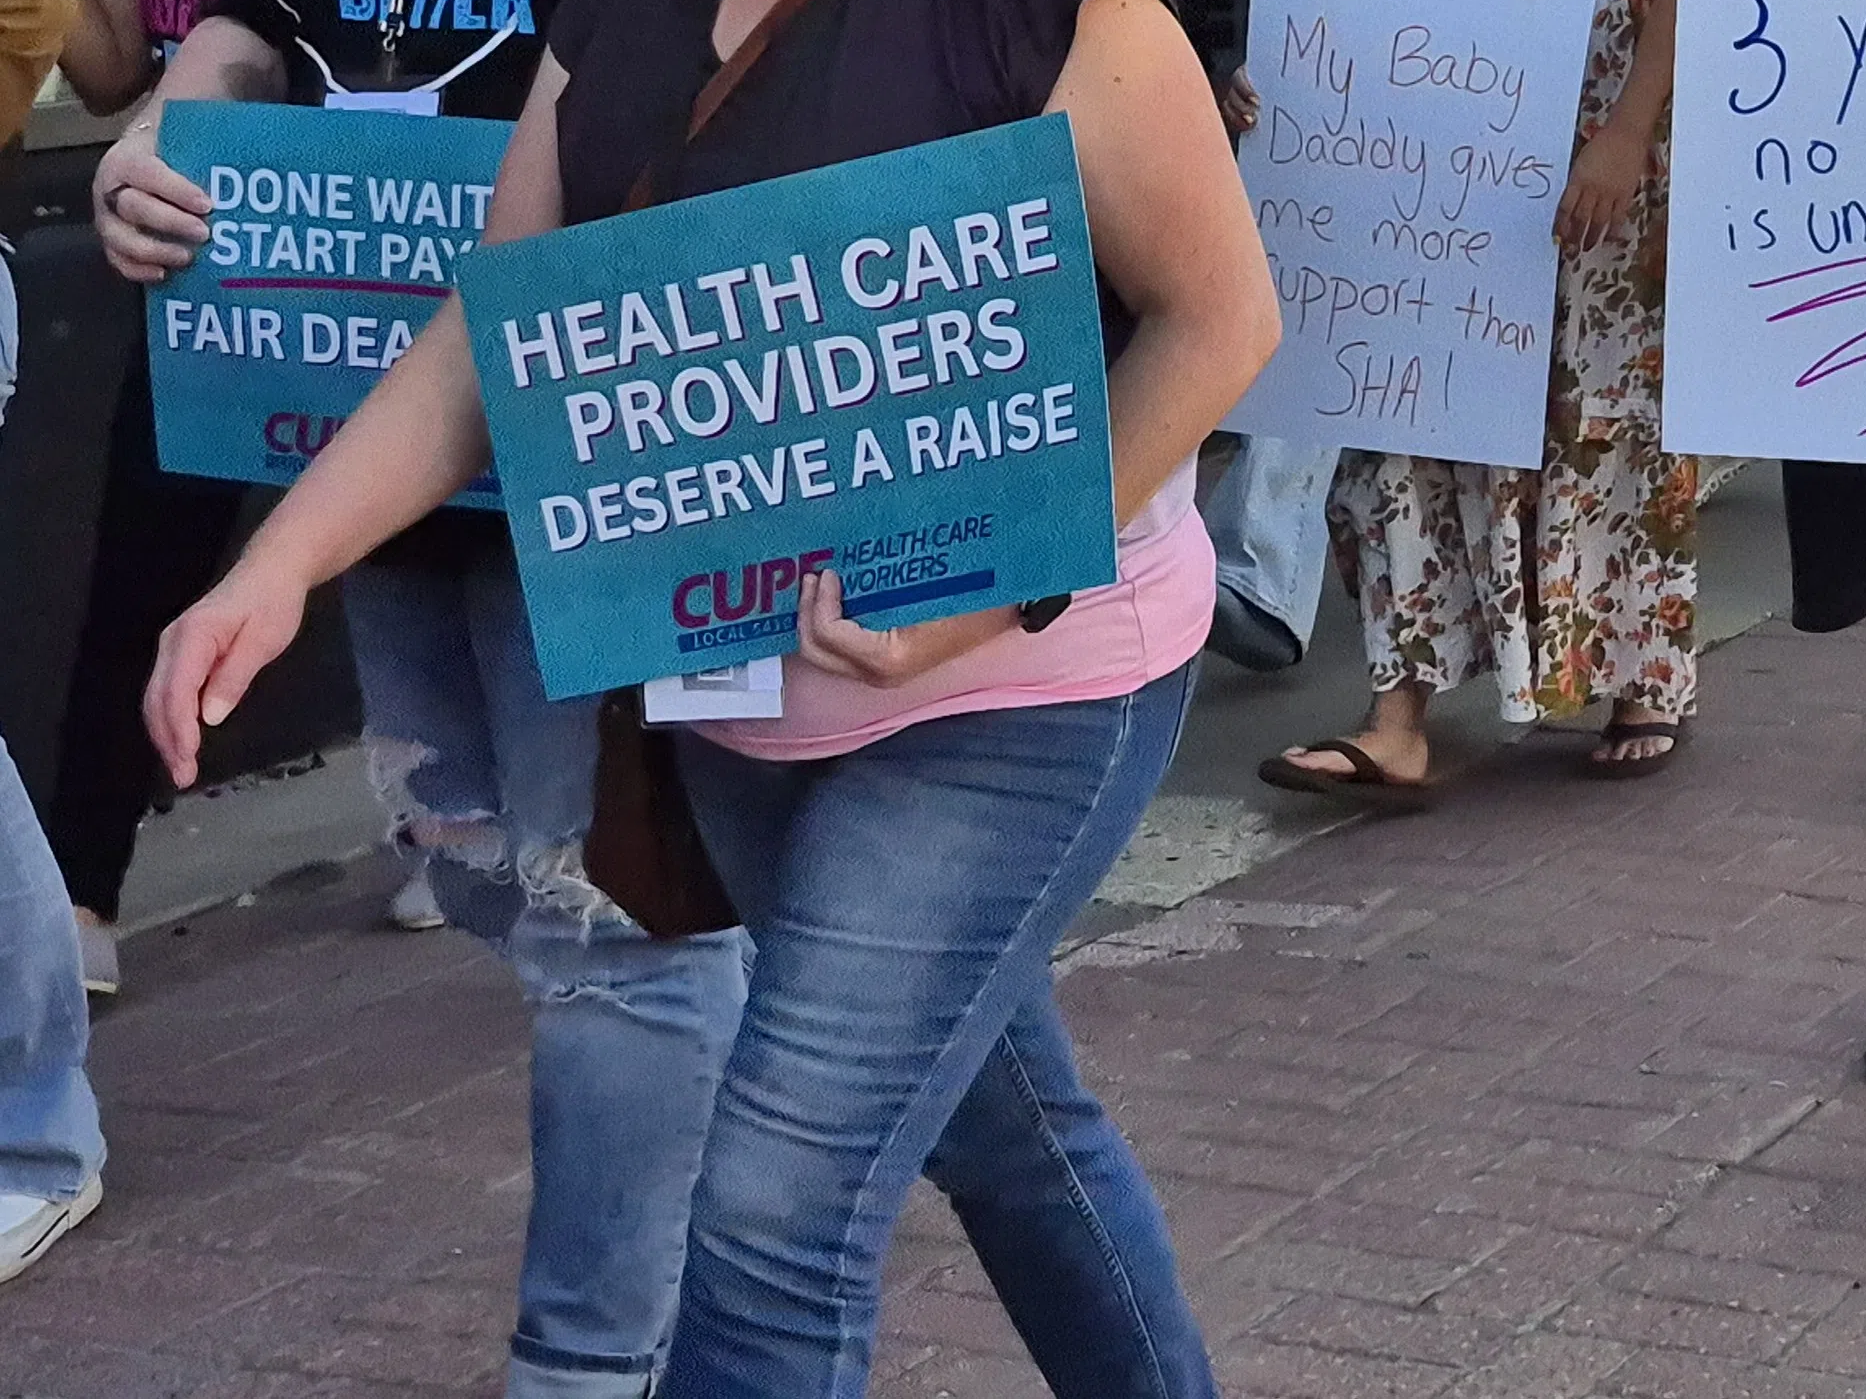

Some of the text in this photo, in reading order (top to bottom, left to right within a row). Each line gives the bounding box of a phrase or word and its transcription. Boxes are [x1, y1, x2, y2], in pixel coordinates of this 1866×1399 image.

[1281, 14, 1524, 134] My Baby
[1269, 104, 1554, 221] Daddy gives
[1755, 136, 1838, 185] no
[210, 165, 494, 230] DONE WAIT
[1726, 205, 1776, 250] is
[209, 220, 366, 276] START
[1256, 198, 1493, 266] me more
[502, 197, 1058, 387] HEALTH CARE
[1455, 285, 1535, 353] than
[165, 299, 414, 370] FAIR DEA
[565, 298, 1026, 463] PROVIDERS
[1316, 341, 1454, 434] SHA!
[264, 412, 347, 458] CU
[539, 383, 1079, 552] DESERVE A RAISE
[841, 527, 926, 569] HEALTH
[932, 513, 995, 549] CARE
[694, 624, 747, 648] LOCAL
